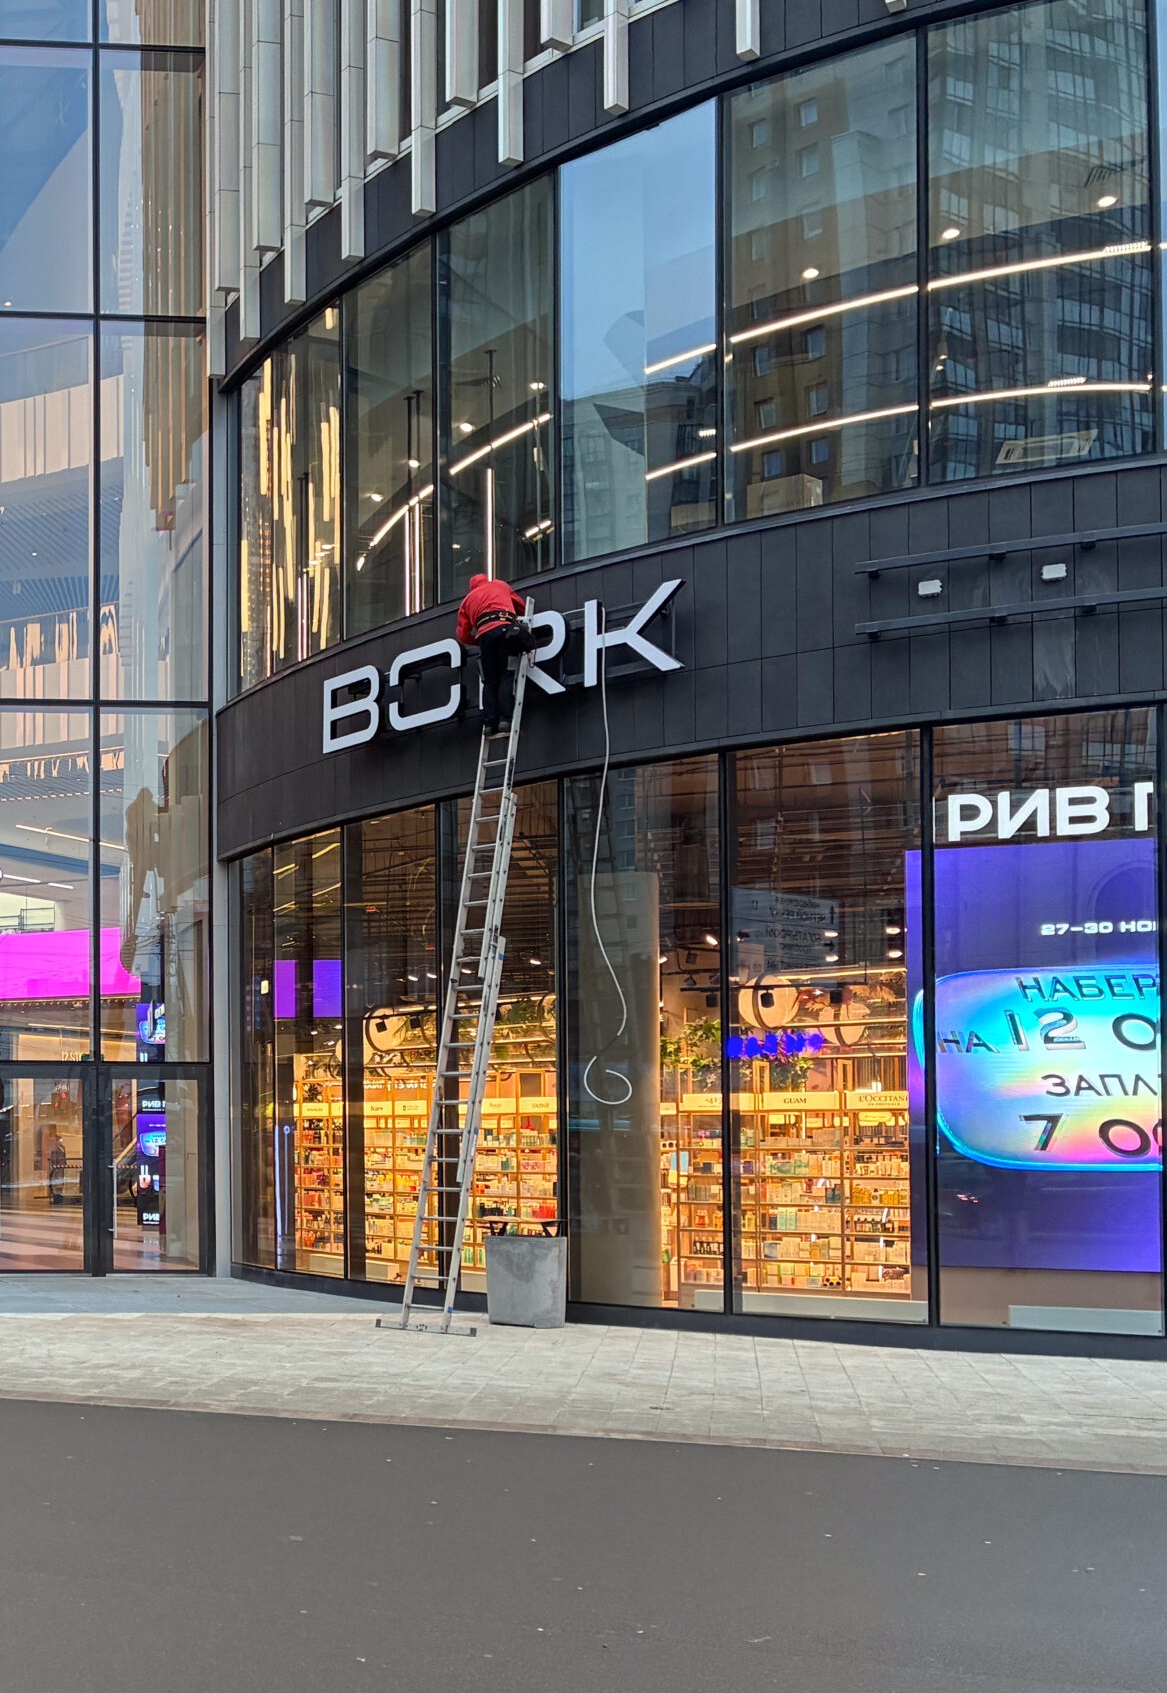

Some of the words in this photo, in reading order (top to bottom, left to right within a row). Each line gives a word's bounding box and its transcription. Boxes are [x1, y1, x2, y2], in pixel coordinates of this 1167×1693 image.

[947, 786, 1110, 842] РИВ
[1014, 973, 1160, 1001] НАБЕР
[936, 1030, 1000, 1053] НА
[1004, 1007, 1086, 1051] 12
[1041, 1074, 1164, 1097] ЗАПЛ
[1019, 1113, 1067, 1151] 7
